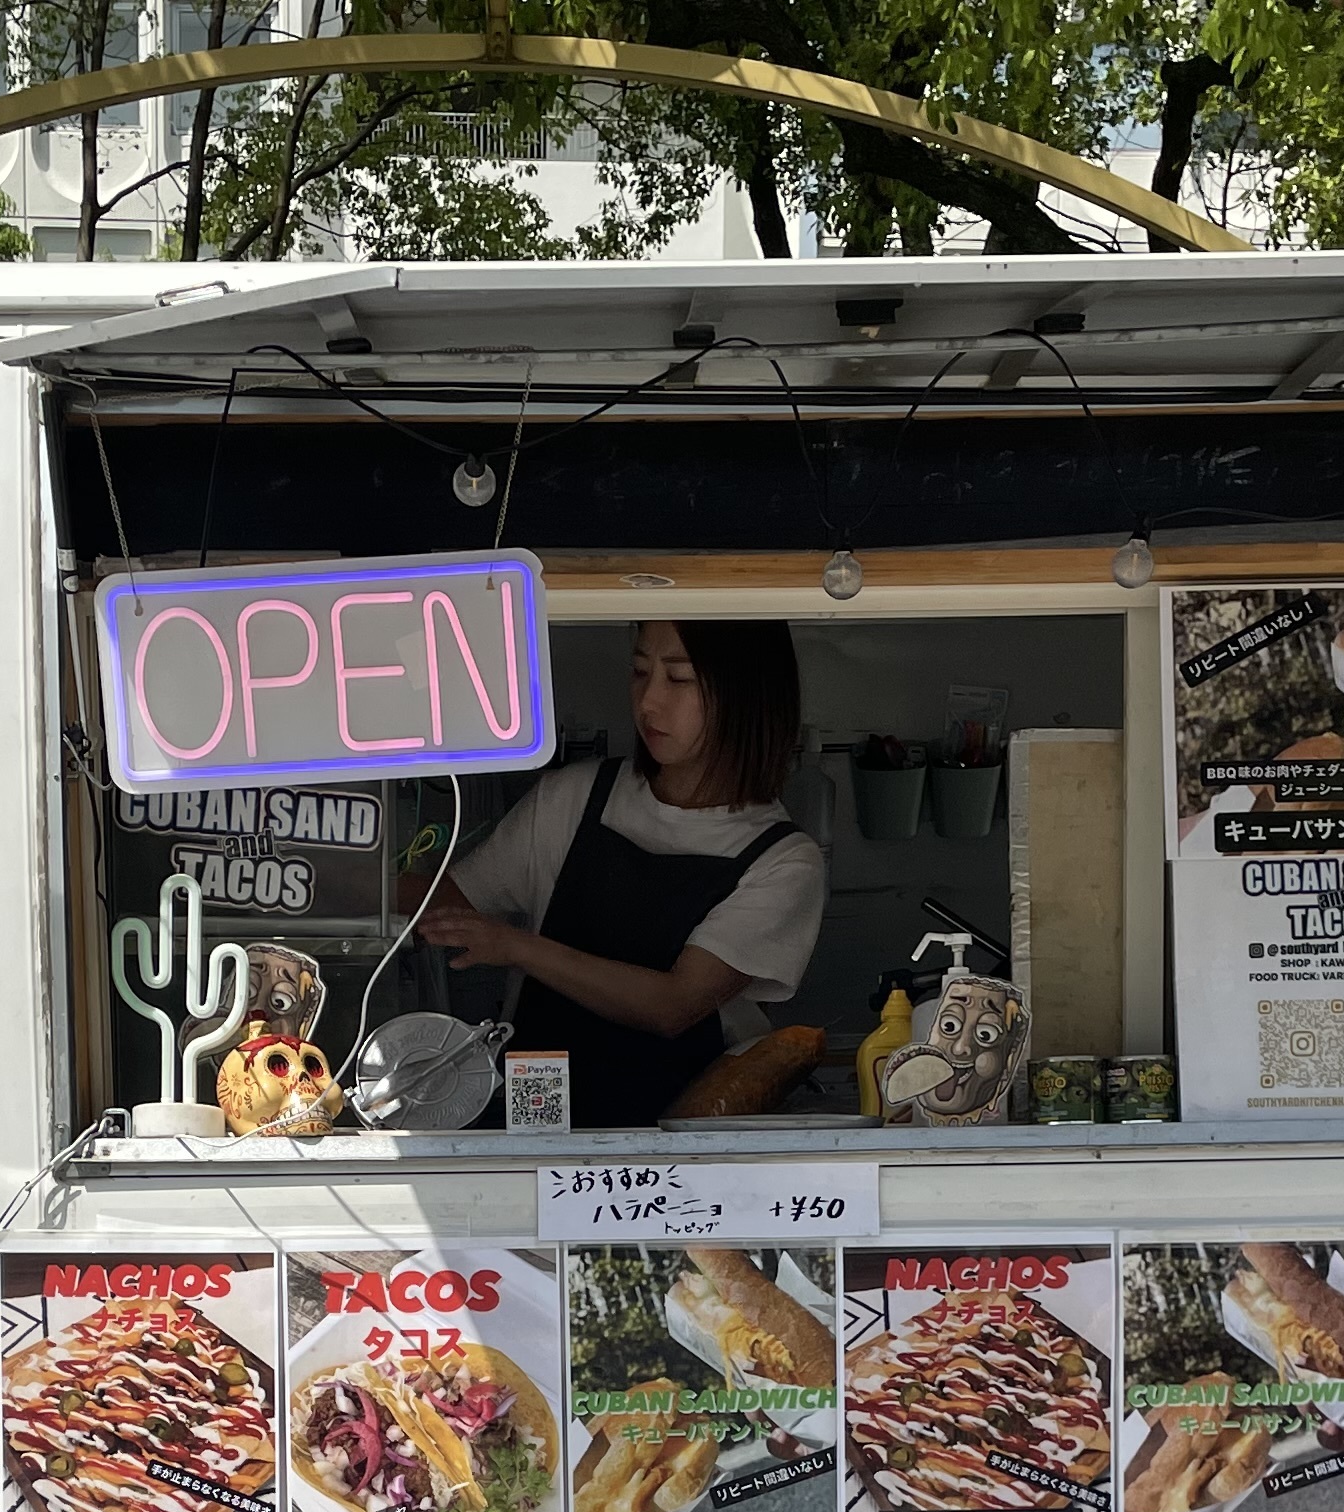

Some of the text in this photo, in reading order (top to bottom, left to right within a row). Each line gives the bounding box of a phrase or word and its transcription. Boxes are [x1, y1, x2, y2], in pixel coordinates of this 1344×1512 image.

[134, 580, 522, 761] OPEN
[119, 788, 381, 850] CUBAN SAND
[224, 827, 276, 859] and
[172, 845, 315, 914] TACOS
[1245, 859, 1340, 895] CUBAN
[1281, 958, 1311, 968] SHOP
[1249, 973, 1278, 982] FOOD
[528, 1063, 563, 1076] PayPay
[571, 1167, 660, 1194] おすすめ
[593, 1195, 723, 1223] ハラペーニョ
[664, 1221, 721, 1234] トッピング
[42, 1263, 235, 1300] NACHOS
[884, 1255, 1074, 1292] NACHOS
[320, 1268, 503, 1316] TACOS
[92, 1308, 199, 1334] ナチョス
[932, 1299, 1037, 1326] ナチョス
[362, 1325, 470, 1362] タコス
[571, 1388, 837, 1416] CUBAN SANDWICH
[1127, 1383, 1228, 1408] CUBAN
[622, 1421, 773, 1445] キューバサンド
[1179, 1412, 1323, 1437] キューバサンド
